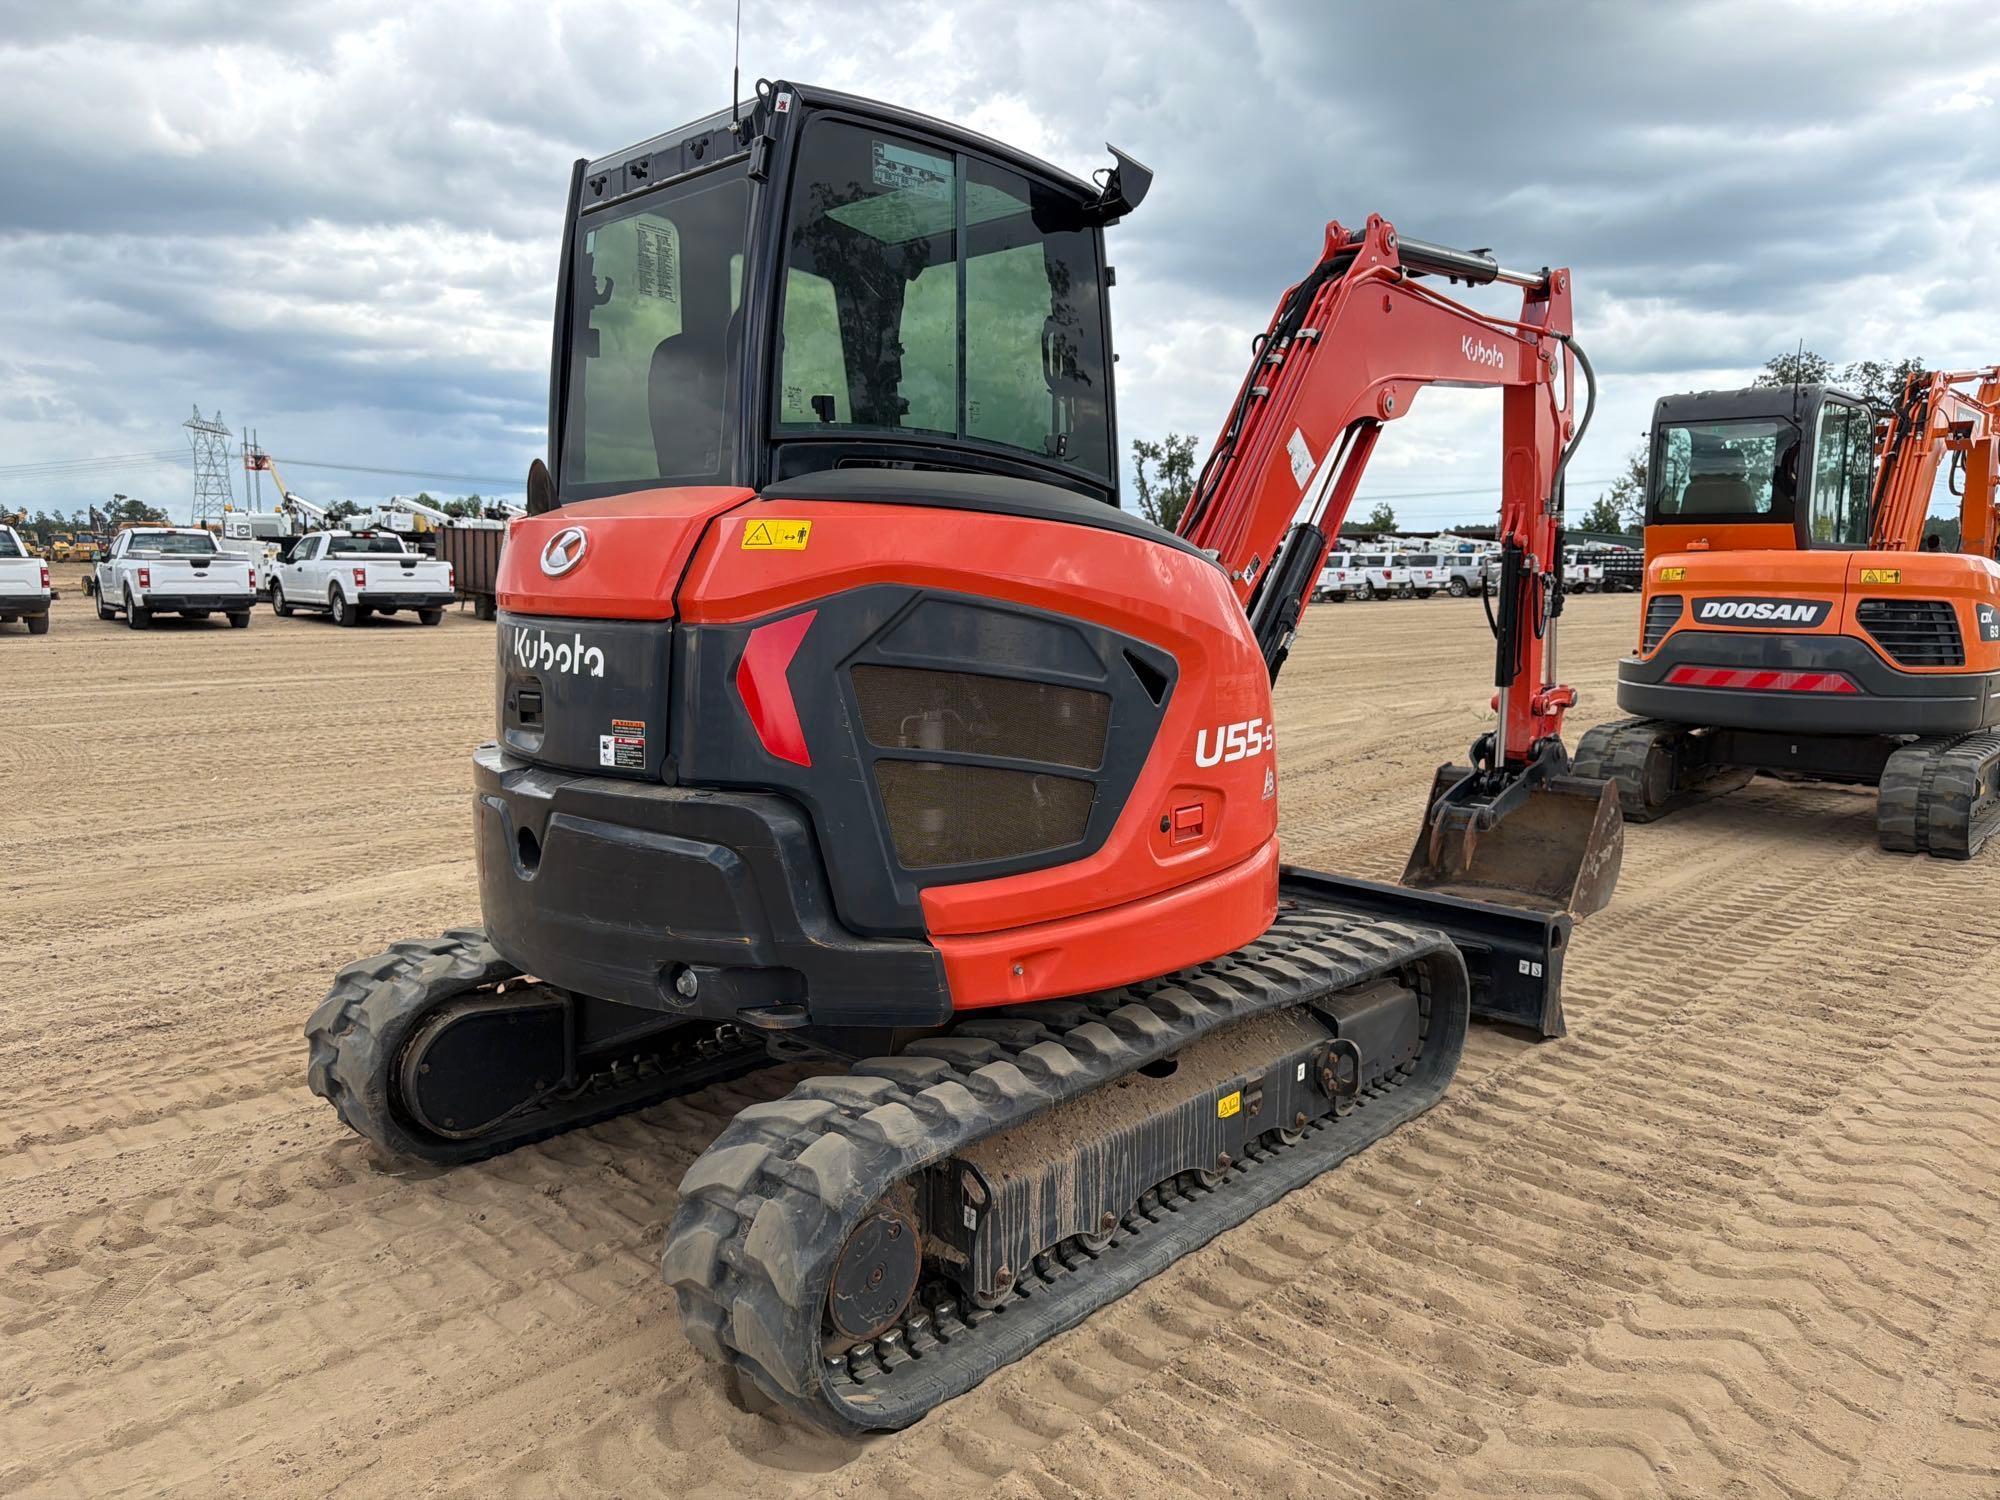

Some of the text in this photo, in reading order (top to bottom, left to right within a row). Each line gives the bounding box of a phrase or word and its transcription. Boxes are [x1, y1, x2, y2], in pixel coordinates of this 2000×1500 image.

[1461, 334, 1504, 369] Kubota
[1700, 602, 1818, 622] DOOSAN
[514, 627, 605, 678] Kubota
